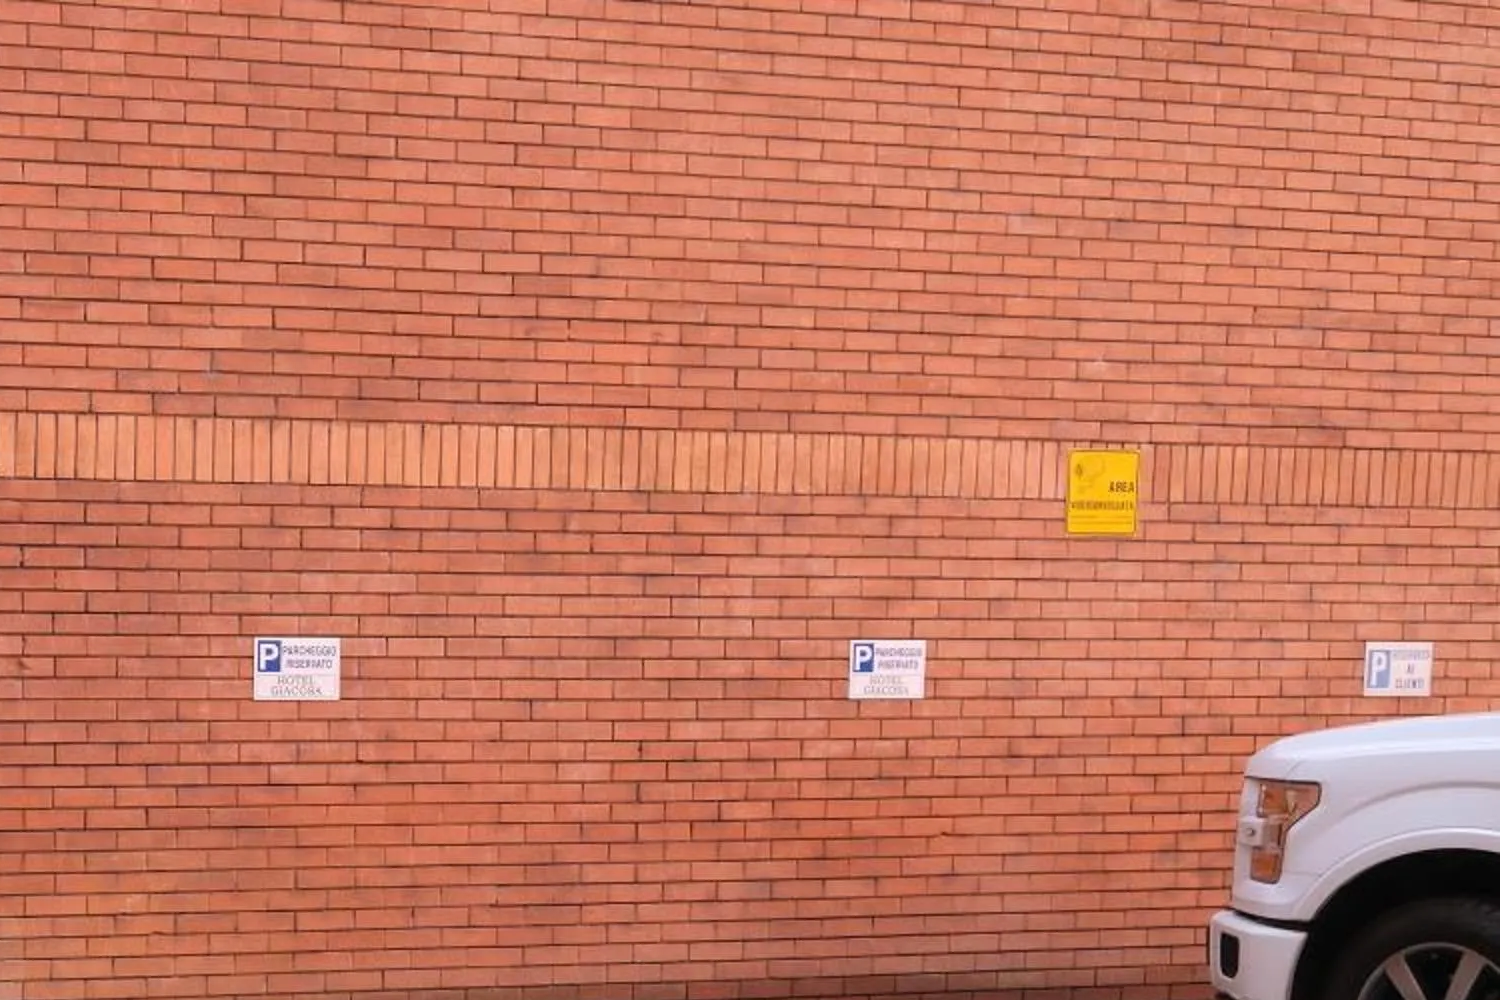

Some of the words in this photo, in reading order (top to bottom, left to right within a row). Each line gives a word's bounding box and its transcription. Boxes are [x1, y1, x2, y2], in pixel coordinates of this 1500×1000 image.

[1108, 481, 1134, 493] AREA
[283, 645, 337, 656] PARCHEGGIO
[260, 643, 279, 671] P
[855, 645, 873, 671] P
[286, 659, 333, 669] RISERVATO
[1371, 651, 1388, 687] P
[277, 676, 315, 685] HOTEL
